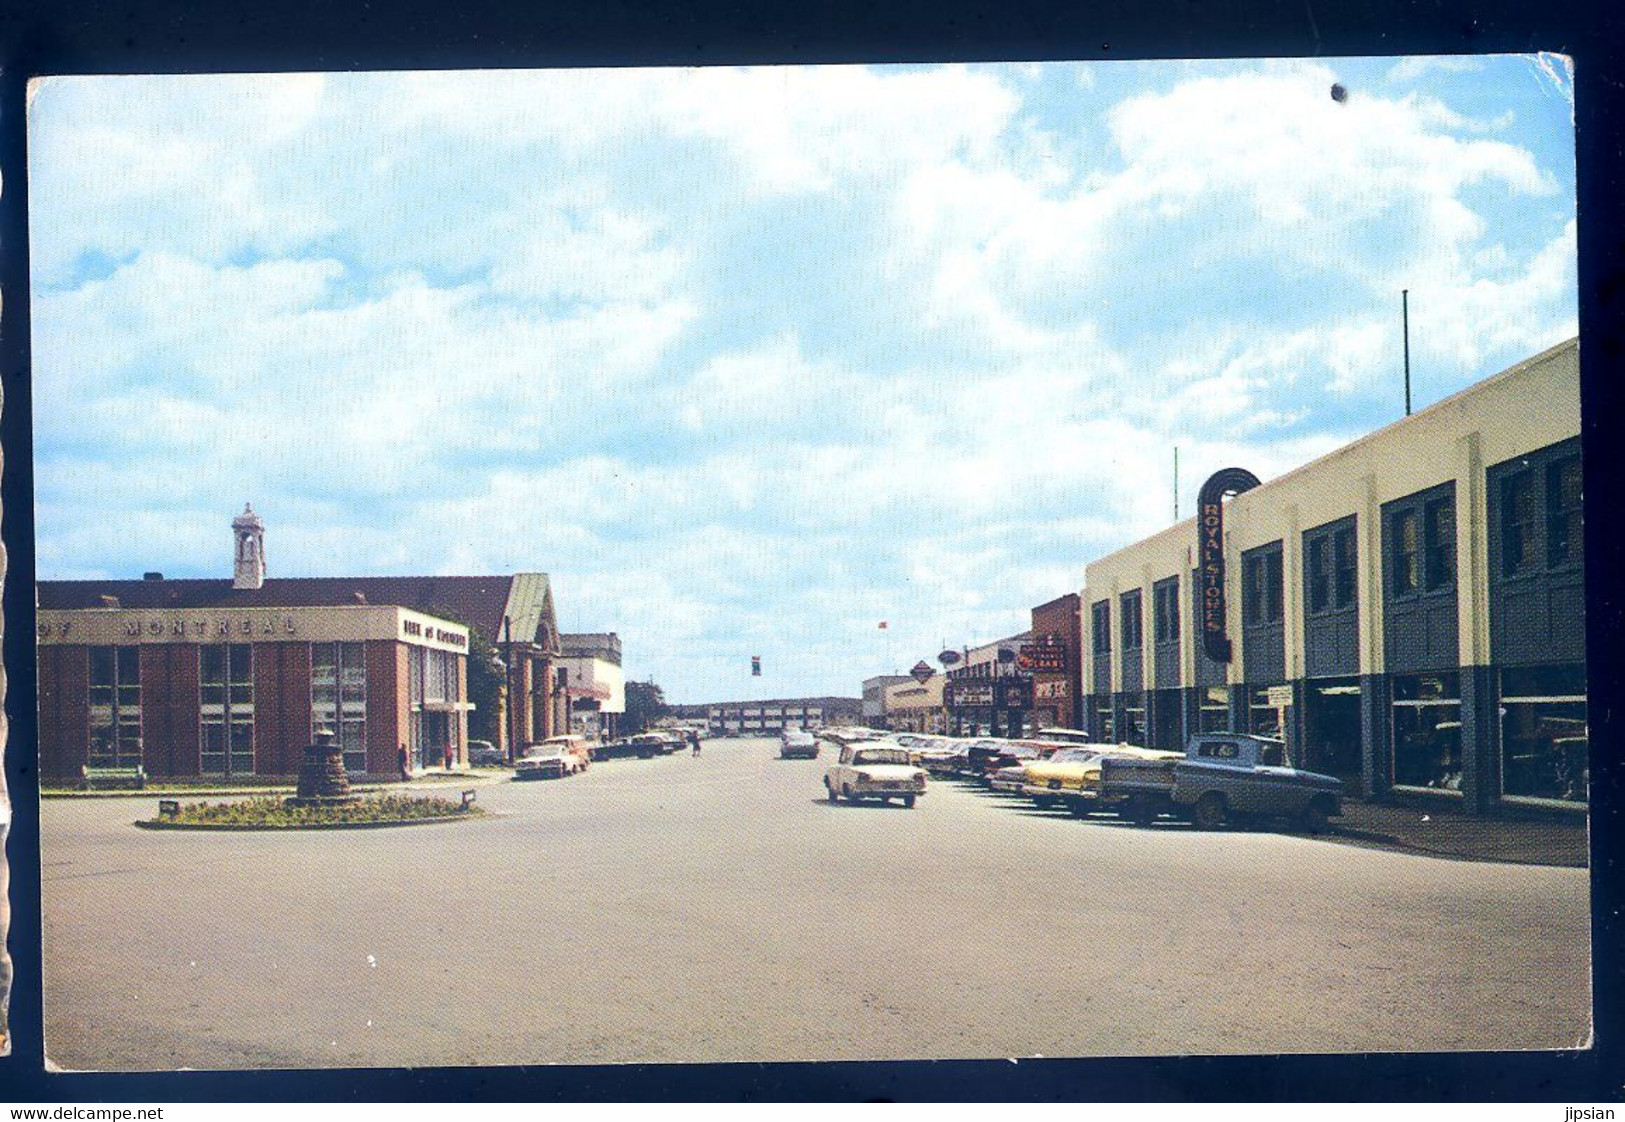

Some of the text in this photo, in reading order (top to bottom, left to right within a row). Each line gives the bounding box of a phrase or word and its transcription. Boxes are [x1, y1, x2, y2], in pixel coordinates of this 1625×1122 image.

[1204, 504, 1221, 632] ROYAL STORES
[38, 616, 297, 636] OF MONTREAL
